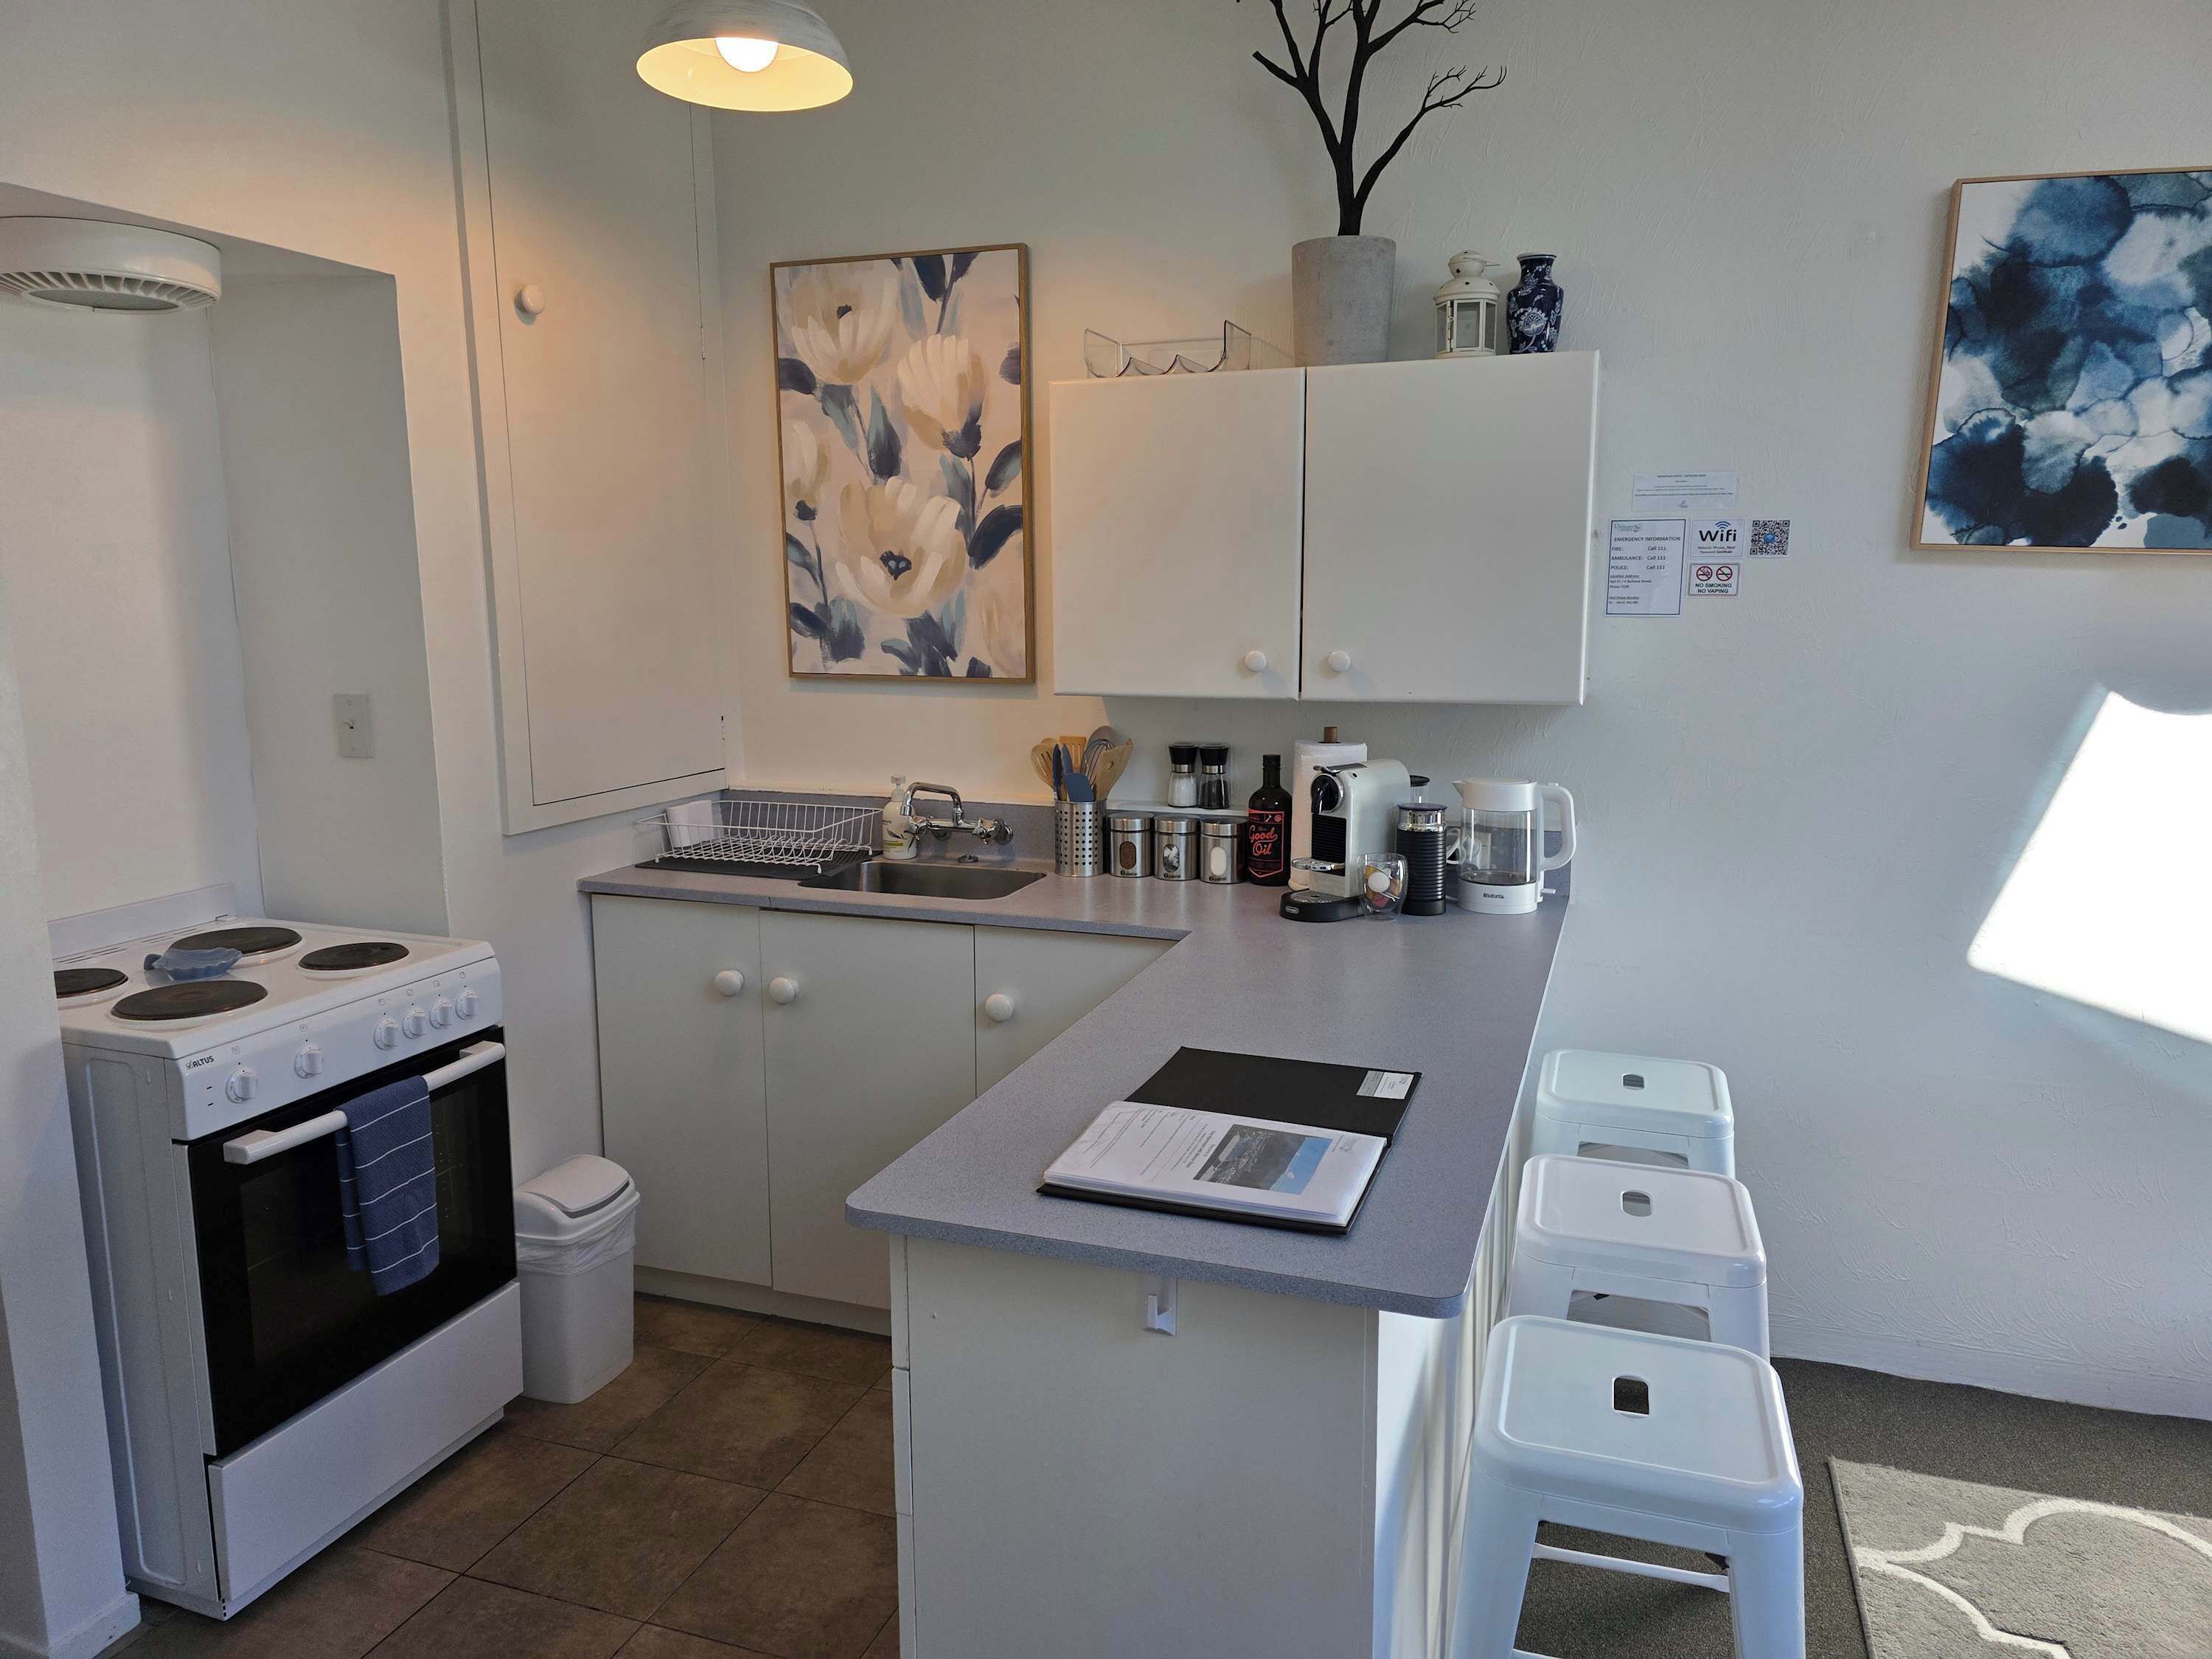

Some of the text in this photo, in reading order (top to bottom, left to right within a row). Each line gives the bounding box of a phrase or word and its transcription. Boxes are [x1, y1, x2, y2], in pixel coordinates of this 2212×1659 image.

[1699, 529, 1737, 542] Wifi
[1249, 824, 1278, 842] Good
[1252, 843, 1273, 856] Oil
[192, 1055, 215, 1068] ALTUS
